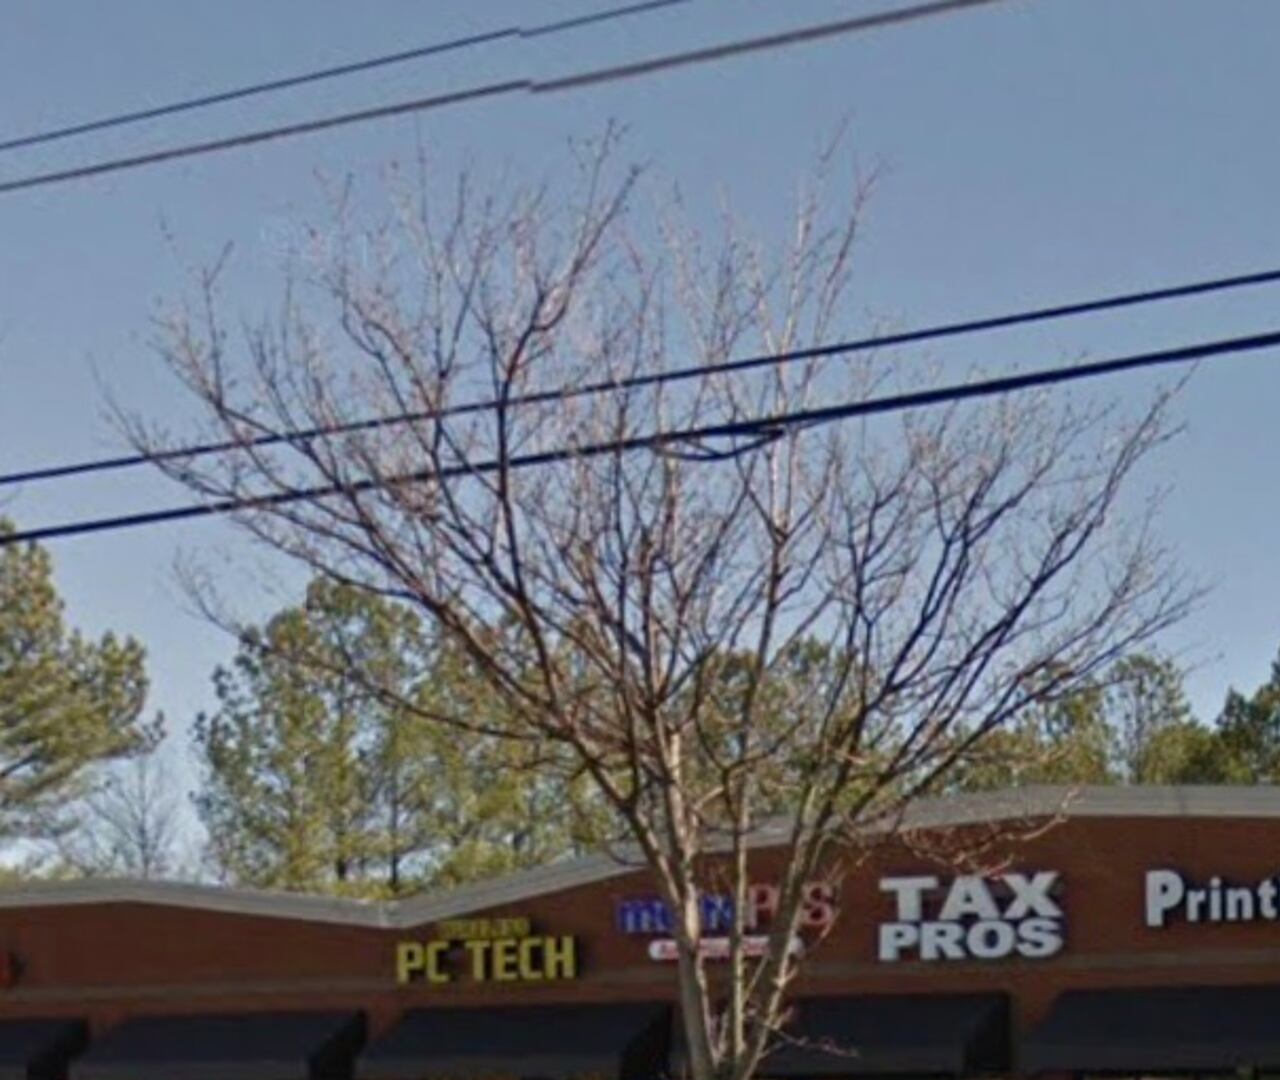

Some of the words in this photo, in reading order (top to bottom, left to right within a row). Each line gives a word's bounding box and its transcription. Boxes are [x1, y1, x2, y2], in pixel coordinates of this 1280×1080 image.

[878, 870, 1065, 922] TAX
[395, 939, 451, 985] PC
[465, 934, 578, 982] TECH
[877, 918, 1065, 962] PROS
